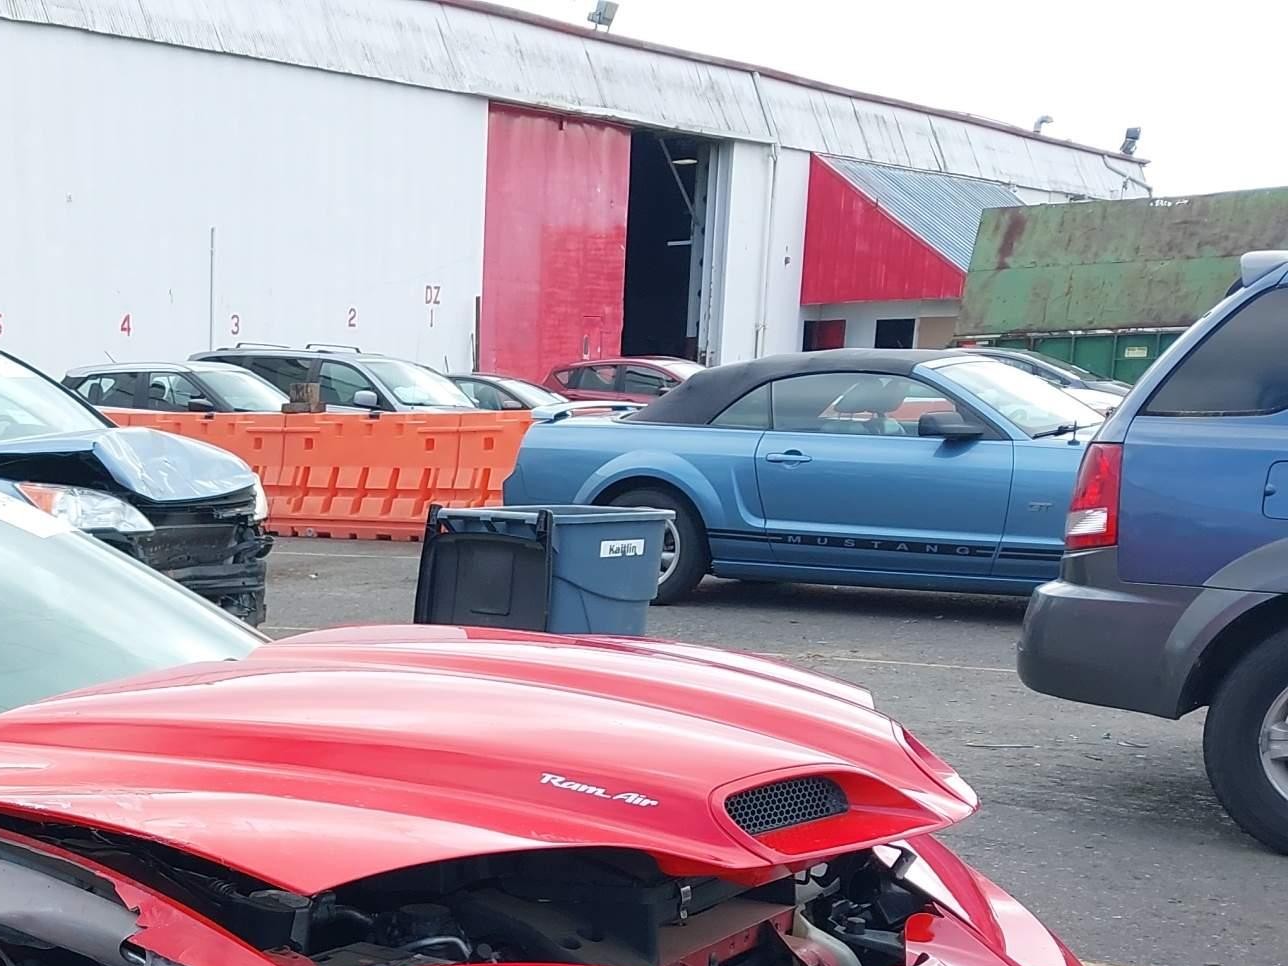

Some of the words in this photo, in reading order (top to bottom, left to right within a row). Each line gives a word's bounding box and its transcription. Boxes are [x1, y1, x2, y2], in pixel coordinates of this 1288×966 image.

[425, 285, 441, 305] DZ
[120, 314, 131, 336] 4
[231, 314, 240, 335] 3
[348, 307, 357, 327] 2
[788, 535, 970, 555] MUSTANG
[540, 772, 612, 799] Ram
[612, 792, 659, 807] Air
